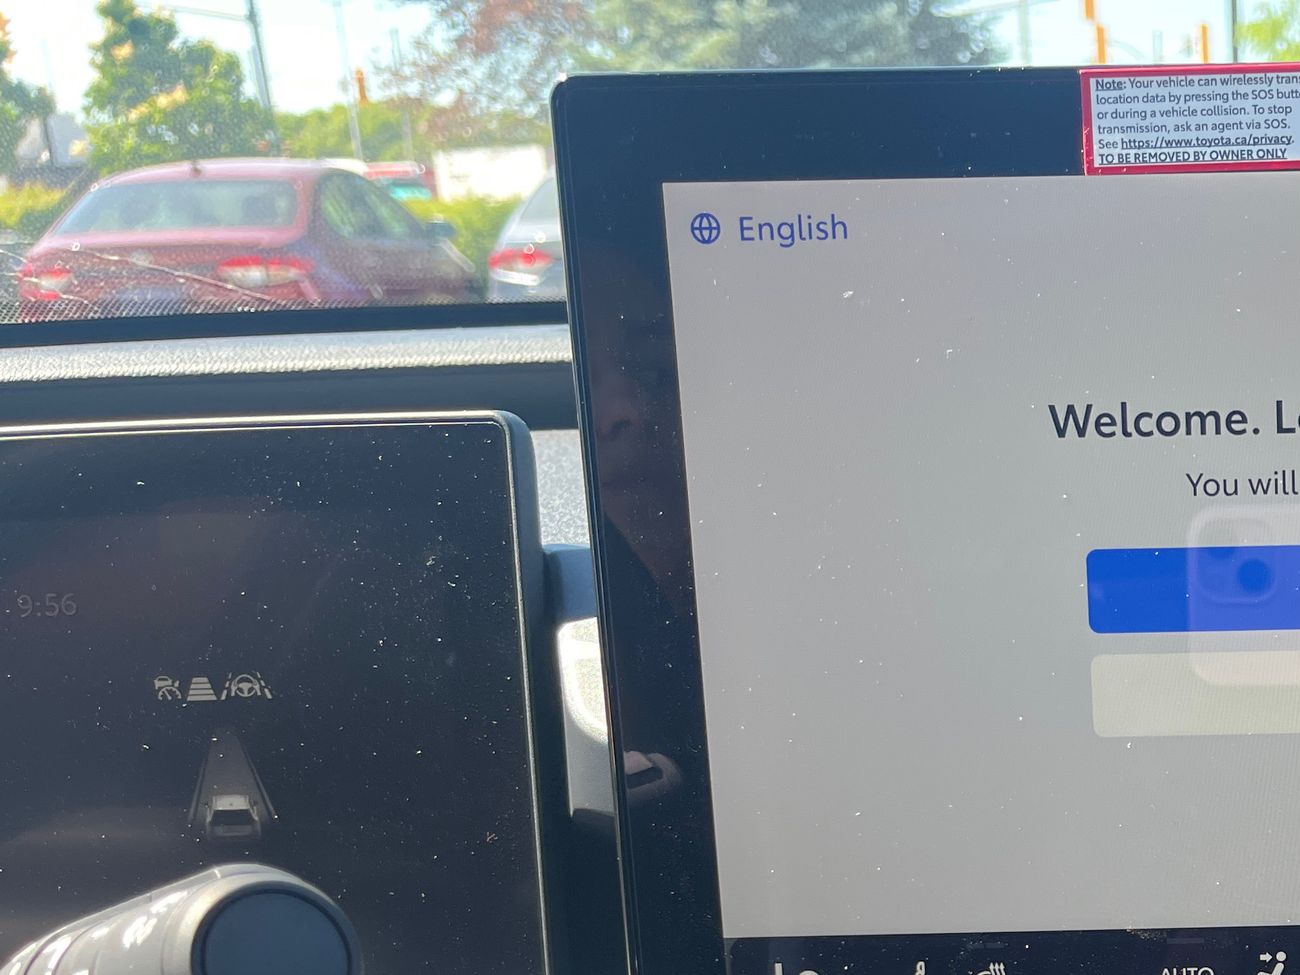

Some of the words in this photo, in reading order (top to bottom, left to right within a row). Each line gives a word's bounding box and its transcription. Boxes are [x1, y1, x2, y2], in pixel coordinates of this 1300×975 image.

[1095, 79, 1126, 90] Note:
[1128, 78, 1156, 88] Your
[1156, 76, 1195, 88] vehicle
[1197, 78, 1217, 87] can
[1220, 74, 1274, 87] wirelessly
[1096, 93, 1140, 105] location
[1142, 92, 1166, 103] data
[1168, 91, 1181, 104] by
[1184, 91, 1229, 104] pressing
[1232, 90, 1249, 100] the
[1251, 89, 1274, 100] SOS
[1097, 111, 1108, 120] or
[1110, 108, 1147, 121] during
[1150, 110, 1157, 118] a
[1159, 106, 1198, 118] vehicle
[1200, 105, 1250, 116] collision.
[1252, 105, 1265, 114] To
[1267, 104, 1292, 116] stop
[1098, 122, 1171, 134] transmission,
[1173, 121, 1192, 132] ask
[1195, 122, 1208, 131] an
[1211, 121, 1244, 133] agent
[1245, 119, 1261, 130] via
[1264, 119, 1291, 129] SOS.
[1098, 139, 1118, 149] See
[1121, 134, 1295, 150] https://www.toyota.ca/privacy.
[1099, 153, 1115, 164] TO
[1117, 153, 1131, 163] BE
[1134, 151, 1190, 163] REMOVED
[1193, 150, 1207, 161] BY
[1209, 149, 1253, 160] OWNER
[1256, 148, 1287, 159] ONLY
[739, 213, 848, 248] English
[1048, 401, 1260, 439] Welcome.
[1185, 472, 1239, 497] You
[1248, 469, 1299, 496] will
[17, 593, 77, 618] 9:56
